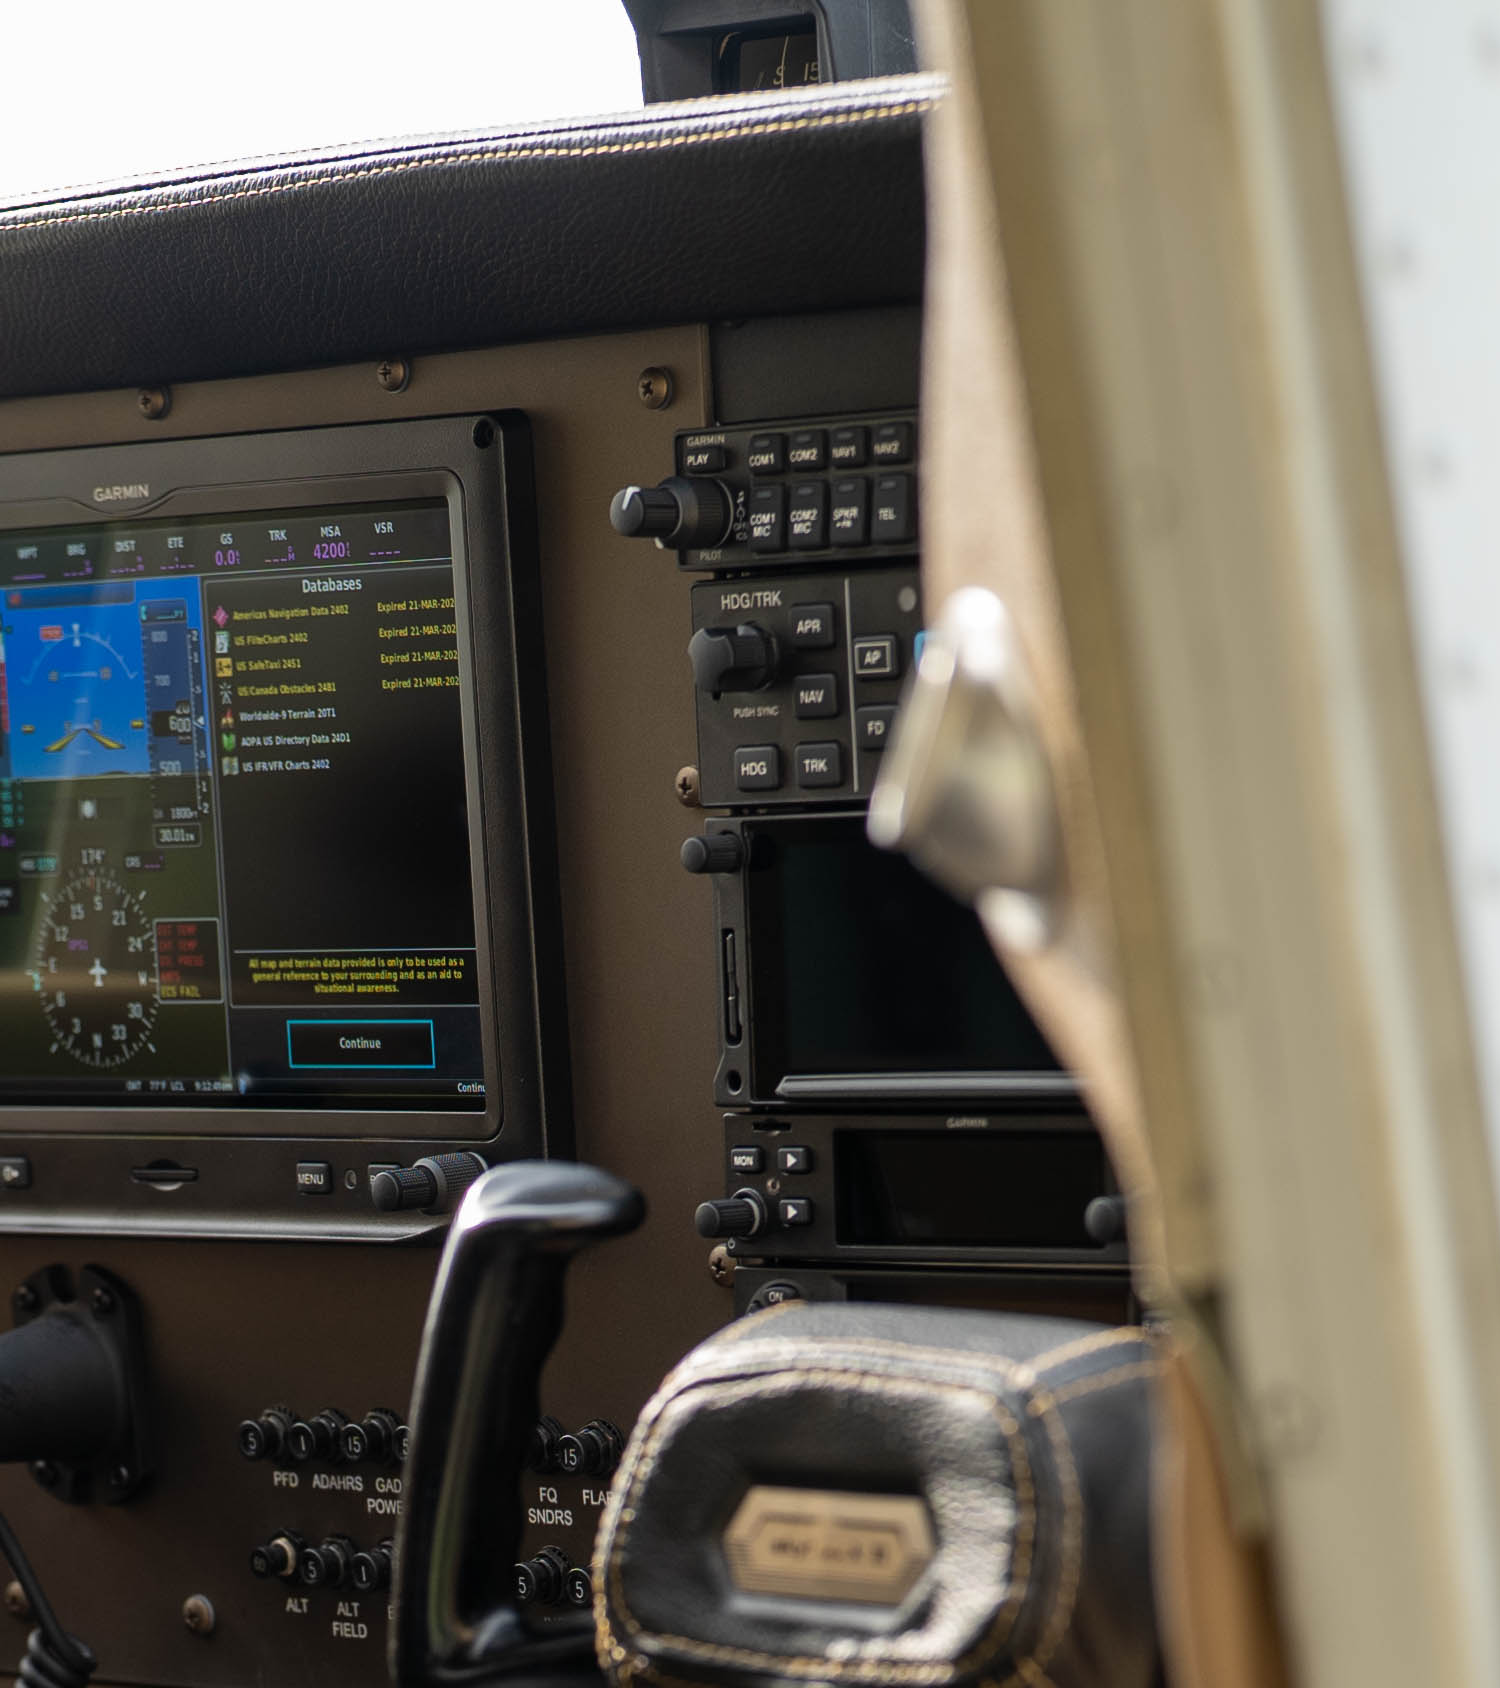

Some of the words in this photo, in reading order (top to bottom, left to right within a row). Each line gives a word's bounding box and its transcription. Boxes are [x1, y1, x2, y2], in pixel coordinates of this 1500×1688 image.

[687, 434, 725, 447] GARMIN
[687, 453, 709, 466] PLAY
[749, 452, 775, 466] COM1
[789, 448, 818, 463] COM2
[94, 485, 149, 502] GARMIN
[750, 512, 776, 526] COM1
[789, 508, 818, 523] COM2
[268, 529, 287, 542] TRK
[320, 525, 341, 538] MSA
[374, 521, 394, 534] VSR
[752, 525, 771, 538] MIC
[792, 521, 812, 535] MIC
[219, 533, 233, 546] GS
[699, 550, 722, 561] PILOT
[301, 577, 362, 594] Databases
[377, 600, 407, 614] Expired
[409, 598, 456, 610] 21-MAR-202
[720, 589, 782, 611] HDG/TRK
[311, 606, 329, 616] Data
[378, 626, 408, 640] Expired
[410, 623, 457, 636] 21-MAR-202
[796, 618, 822, 635] APR
[380, 652, 410, 665] Expired
[411, 649, 459, 662] 21-MAR-202
[863, 649, 882, 666] AP
[382, 677, 412, 691] Expired
[413, 675, 461, 688] 21-MAR-202
[799, 689, 824, 705] NAV
[287, 708, 316, 720] Terrain
[733, 707, 755, 719] PUSH
[756, 706, 780, 718] SYNC
[867, 720, 885, 737] FD
[263, 735, 273, 746] US
[275, 734, 310, 748] Directory
[311, 733, 330, 744] Data
[242, 762, 253, 772] US
[285, 760, 310, 771] Charts
[740, 761, 768, 777] HDG
[803, 758, 828, 774] TRK
[112, 909, 126, 926] 21
[127, 936, 144, 952] 24
[278, 958, 293, 968] and
[323, 957, 341, 968] data
[341, 957, 376, 970] provided
[386, 957, 404, 968] only
[405, 957, 414, 967] to
[415, 956, 426, 967] be
[427, 956, 446, 967] used
[448, 958, 458, 967] as
[283, 971, 320, 981] reference
[330, 971, 348, 982] your
[350, 970, 398, 982] surrounding
[399, 970, 415, 980] and
[416, 970, 426, 980] as
[427, 971, 438, 980] an
[439, 969, 452, 980] aid
[453, 970, 463, 979] to
[314, 983, 355, 993] situational
[127, 1002, 143, 1019] 30
[112, 1024, 127, 1041] 33
[339, 1036, 382, 1050] Continue
[733, 1154, 754, 1167] MON
[297, 1173, 325, 1185] MENU
[768, 1291, 784, 1302] ON
[248, 1432, 257, 1450] 5
[348, 1436, 361, 1453] 15
[564, 1448, 577, 1467] 15
[273, 1470, 299, 1488] PFD
[312, 1472, 364, 1492] ADAHRS
[375, 1476, 402, 1494] GAD
[538, 1486, 558, 1504] FQ
[367, 1497, 403, 1516] POWE
[528, 1507, 573, 1527] SNDRS
[307, 1563, 317, 1579] 5
[518, 1576, 527, 1594] 5
[575, 1581, 584, 1599] 5
[285, 1597, 309, 1614] ALT
[336, 1602, 360, 1617] ALT
[332, 1620, 368, 1639] FIELD
